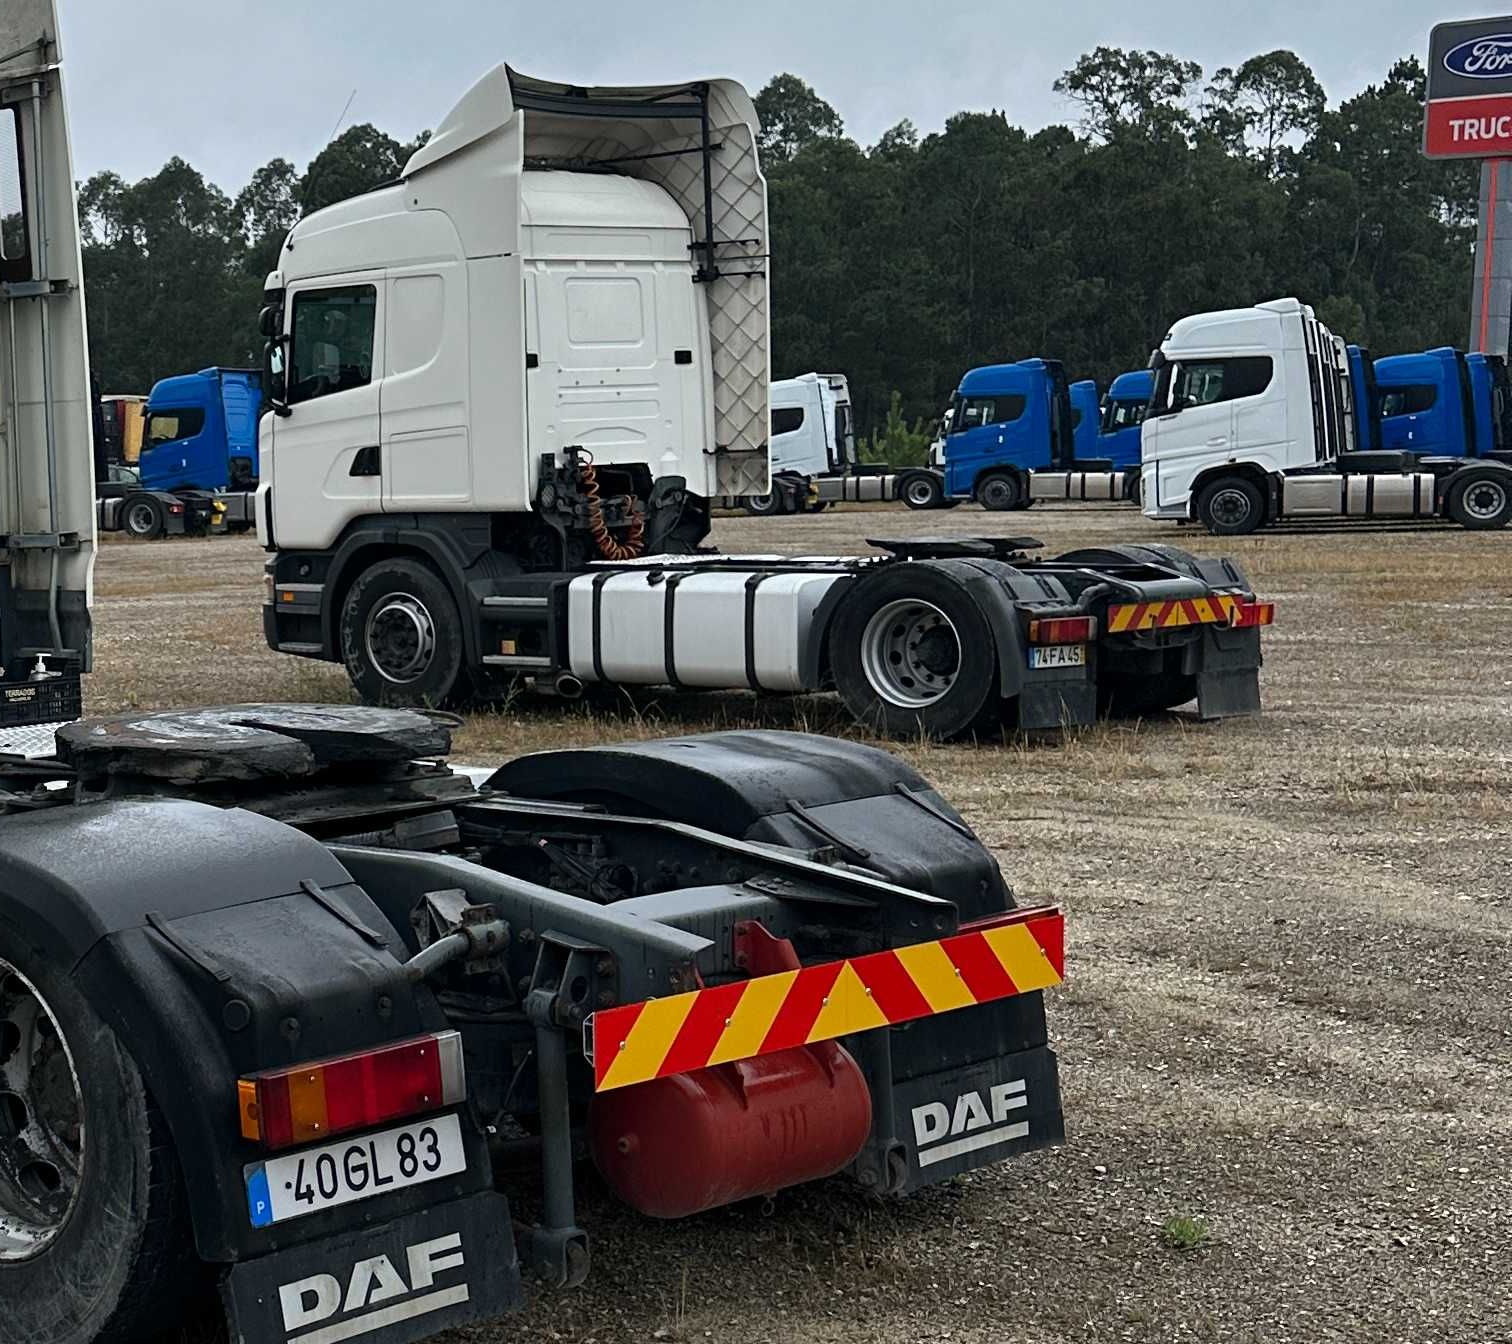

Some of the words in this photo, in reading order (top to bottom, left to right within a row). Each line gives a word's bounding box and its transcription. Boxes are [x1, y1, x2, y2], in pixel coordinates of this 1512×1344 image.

[1464, 40, 1512, 72] For
[1449, 115, 1512, 142] TRUC
[911, 1078, 1028, 1145] DAF
[257, 1200, 265, 1215] P
[278, 1232, 465, 1332] DAF
